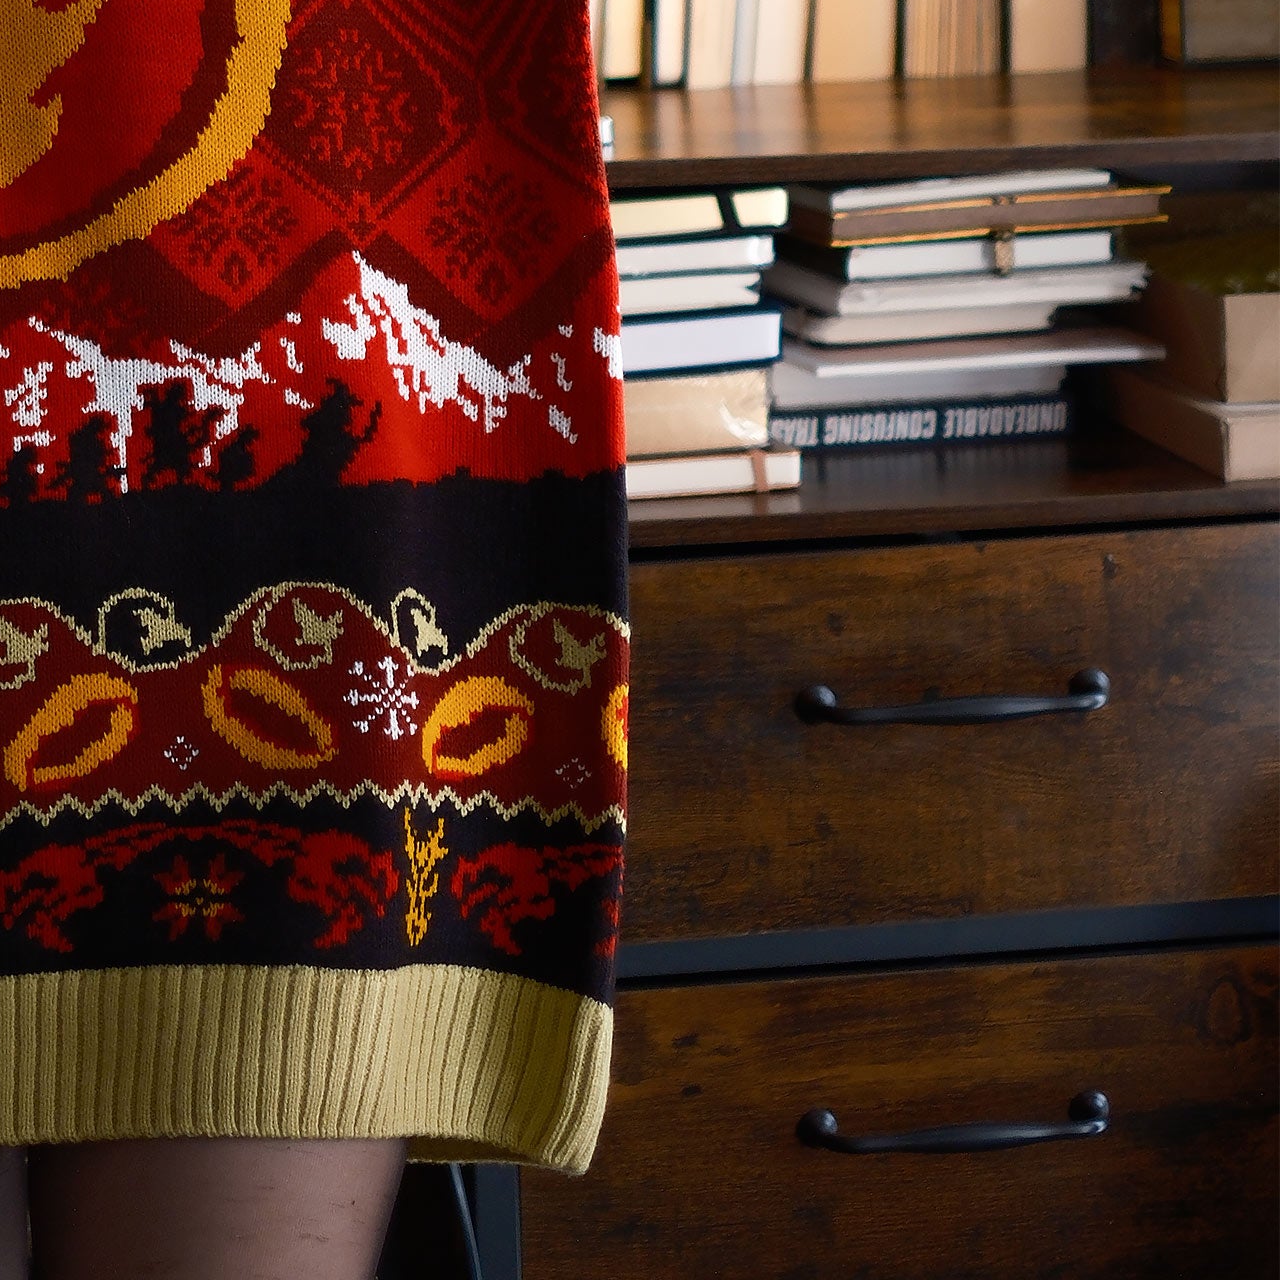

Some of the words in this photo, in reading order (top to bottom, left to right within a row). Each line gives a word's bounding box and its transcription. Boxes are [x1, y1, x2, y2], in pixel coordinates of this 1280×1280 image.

[769, 417, 818, 446] TRAS
[822, 409, 937, 444] CONFUSING
[942, 402, 1068, 439] UNREADABLE
